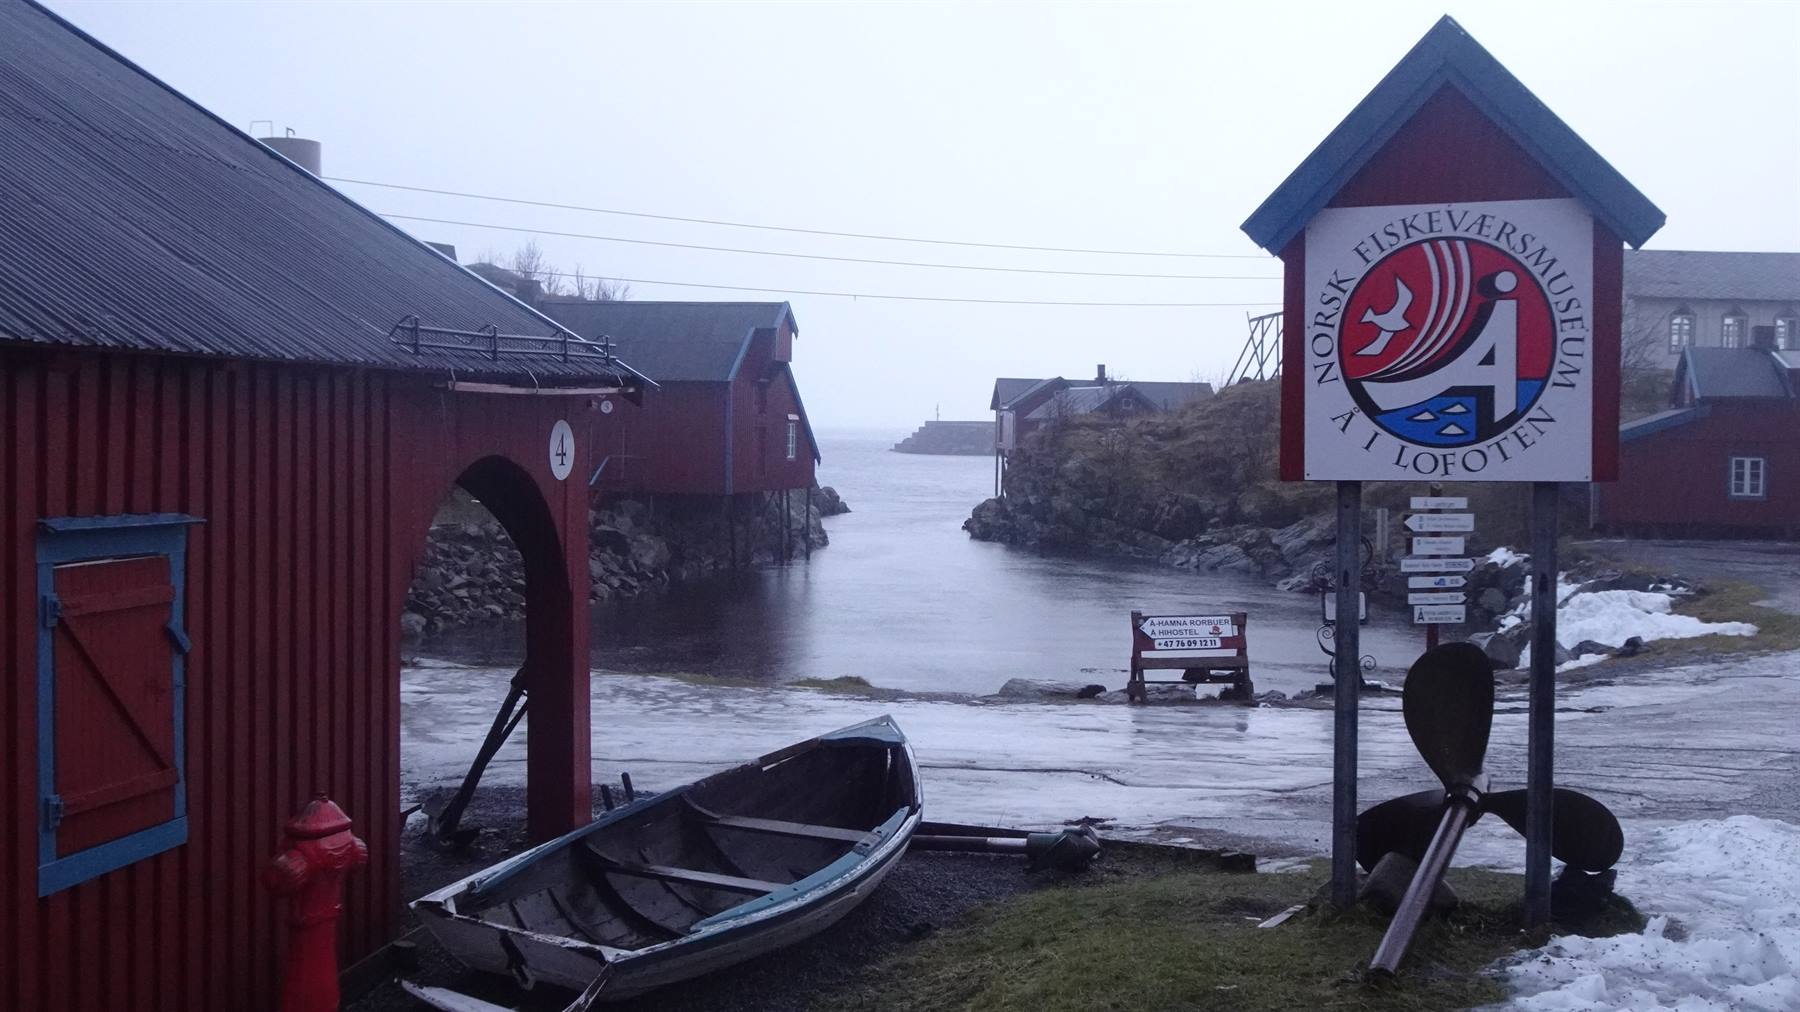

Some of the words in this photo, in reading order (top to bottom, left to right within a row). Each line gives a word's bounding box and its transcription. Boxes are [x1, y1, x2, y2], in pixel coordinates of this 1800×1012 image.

[1311, 269, 1357, 387] NORSK
[1351, 209, 1585, 390] FISKEVÆRSMUSEUM
[555, 433, 567, 466] 4
[1331, 405, 1361, 434] Å
[1362, 430, 1382, 452] I
[1392, 403, 1558, 478] LOFOTEN
[1158, 628, 1200, 636] HIHOSTEL
[1189, 618, 1230, 626] RORBUER
[1175, 639, 1186, 647] 76
[1187, 639, 1197, 647] 09
[1199, 639, 1208, 647] 12
